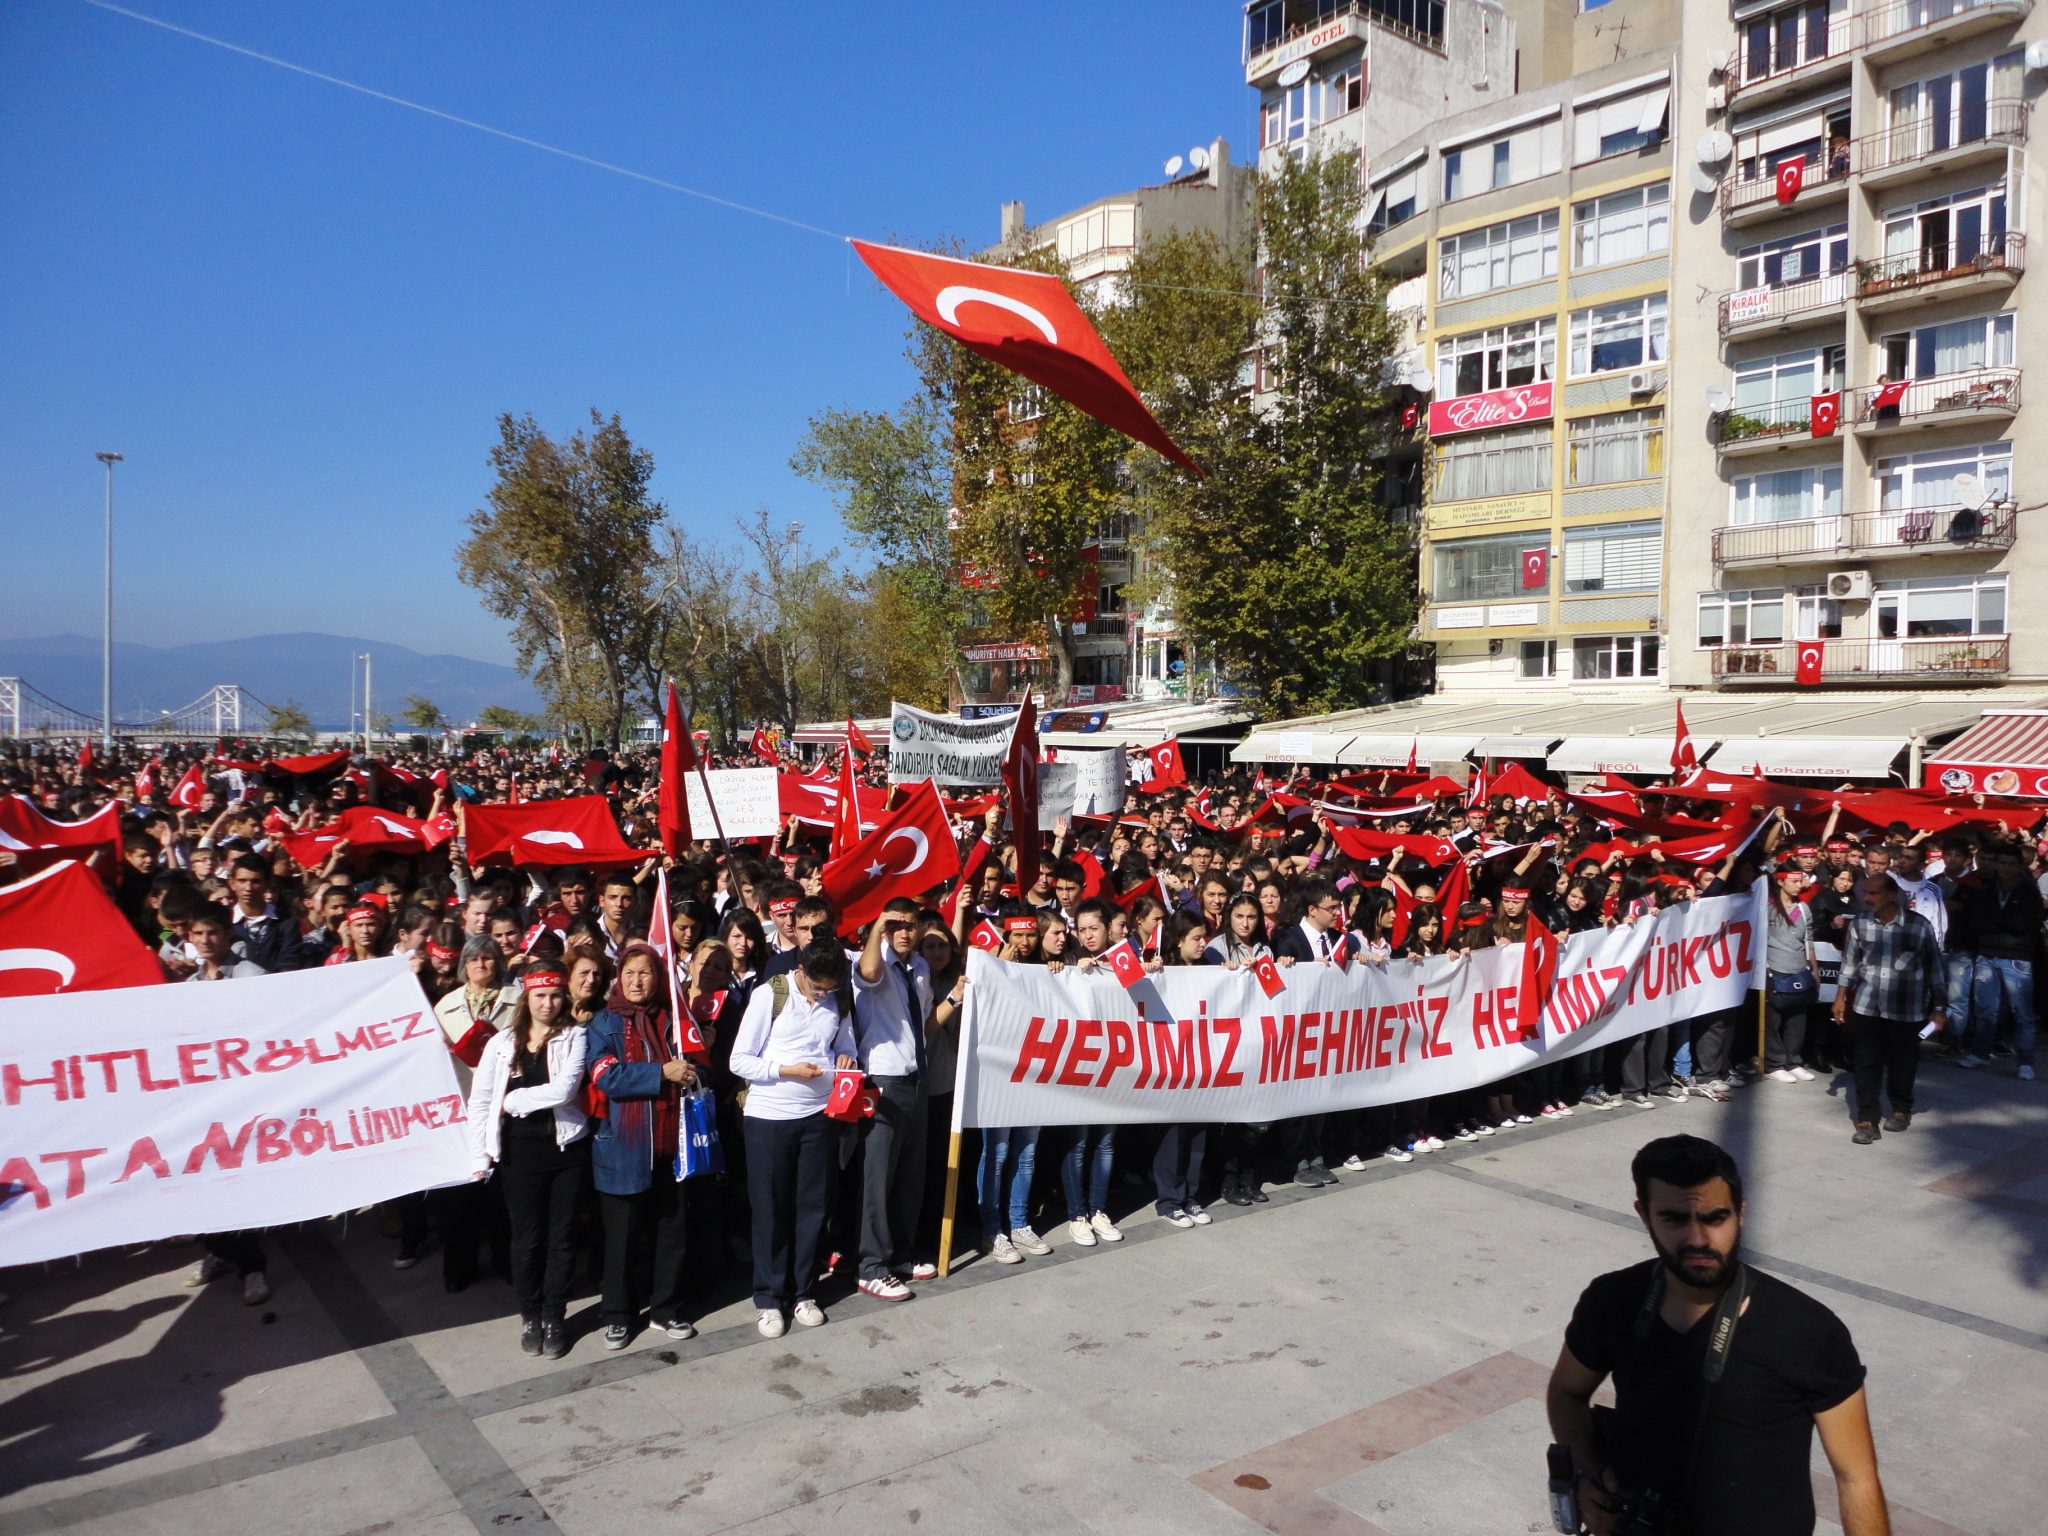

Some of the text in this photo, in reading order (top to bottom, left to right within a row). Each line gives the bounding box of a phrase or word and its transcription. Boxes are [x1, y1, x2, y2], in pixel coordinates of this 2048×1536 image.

[1312, 24, 1345, 47] OTEL
[1733, 310, 1746, 319] 713
[888, 751, 935, 776] BANDIRMA
[937, 751, 969, 777] SAĞLIK
[1765, 766, 1850, 775] Lokantası
[1010, 1000, 1244, 1090] HEPİMİZ
[1258, 984, 1453, 1085] MEHMET'İZ
[1712, 1316, 1731, 1353] Nikon
